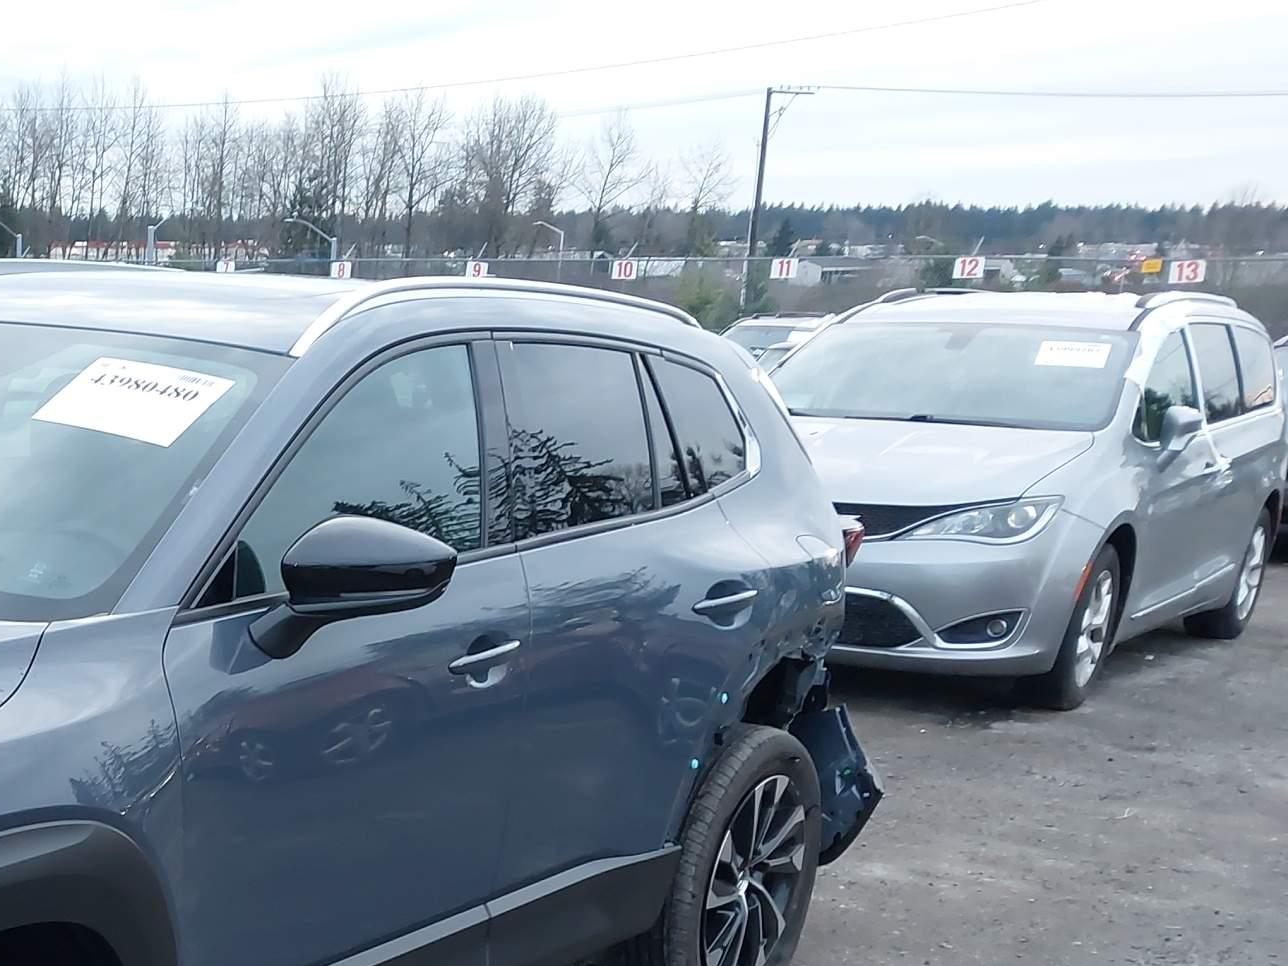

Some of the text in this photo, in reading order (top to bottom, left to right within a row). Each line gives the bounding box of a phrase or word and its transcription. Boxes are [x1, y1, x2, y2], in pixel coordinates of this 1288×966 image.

[337, 263, 345, 278] 8
[472, 263, 481, 278] 9
[617, 261, 633, 278] 10
[777, 260, 791, 277] 11
[959, 259, 979, 277] 12
[1176, 261, 1199, 282] 13
[90, 373, 199, 402] 43980480
